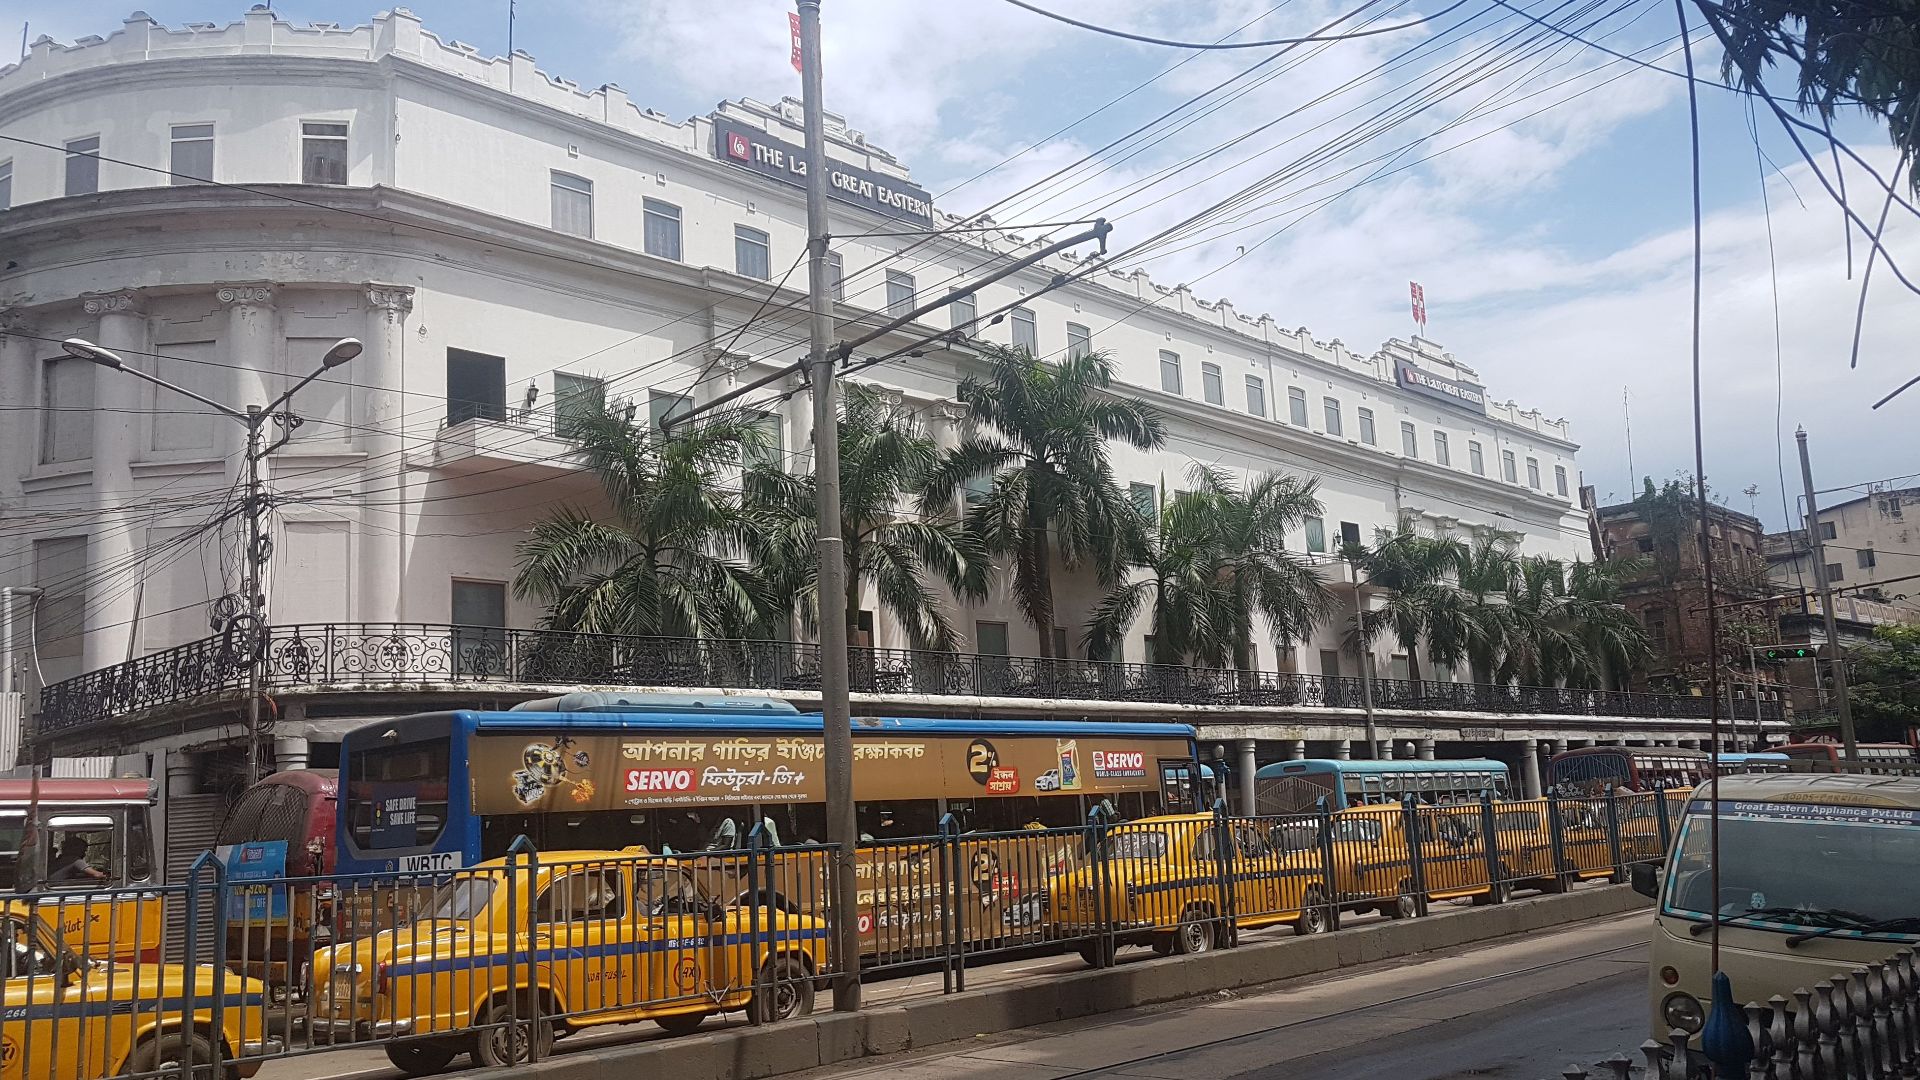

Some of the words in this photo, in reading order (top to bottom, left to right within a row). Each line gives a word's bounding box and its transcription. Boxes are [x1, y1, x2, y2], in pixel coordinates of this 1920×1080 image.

[751, 142, 784, 169] THE
[831, 171, 874, 198] GREAT
[877, 186, 932, 218] EASTERN
[622, 740, 706, 761] আপনার
[712, 737, 770, 765] গাড়ির
[853, 741, 925, 761] রক্ষাকবচ
[1107, 753, 1143, 768] SERVO
[627, 769, 691, 791] SERVO
[385, 799, 399, 812] SAFE
[400, 797, 416, 810] DRIVE
[1735, 802, 1762, 811] Great
[1766, 804, 1808, 813] Eastern
[1811, 806, 1868, 816] Appliance
[390, 812, 404, 826] SAVE
[404, 811, 416, 824] LIFE
[1868, 817, 1913, 825] One
[407, 853, 452, 873] WBTC
